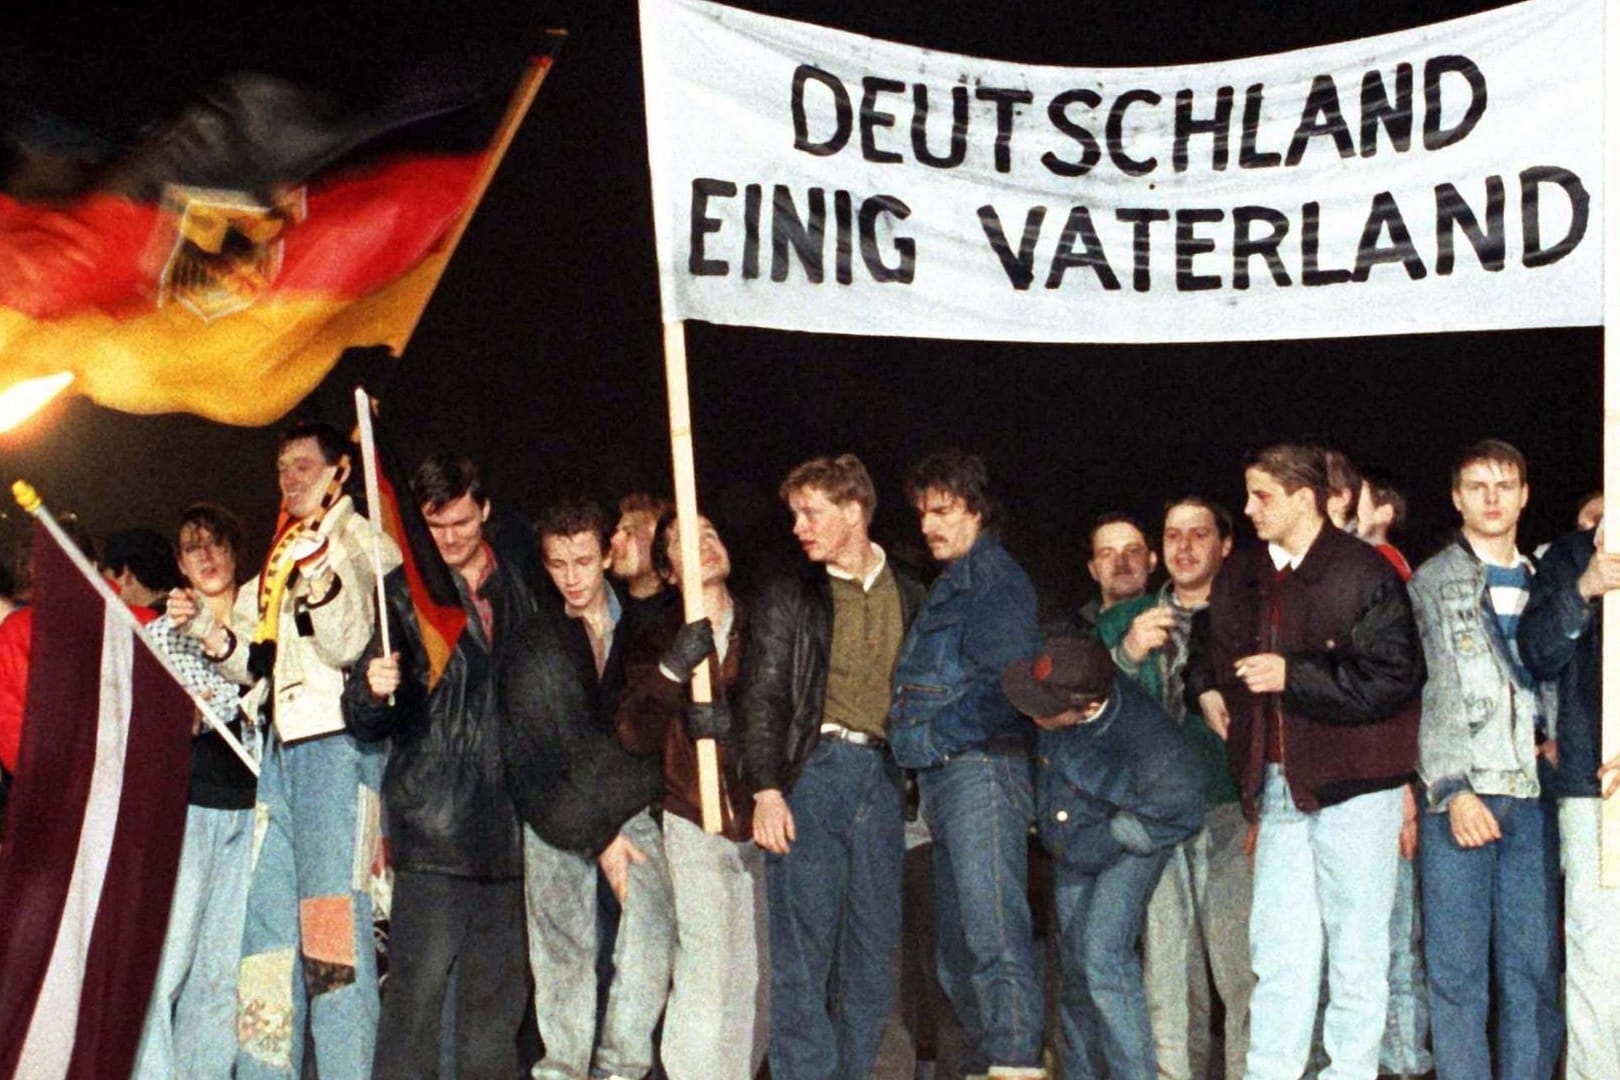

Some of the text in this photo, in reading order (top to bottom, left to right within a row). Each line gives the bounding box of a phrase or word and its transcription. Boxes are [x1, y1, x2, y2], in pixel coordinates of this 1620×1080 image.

[791, 54, 1487, 177] DEUTSCHLAND
[689, 165, 1590, 292] EINIG VATERLAND
